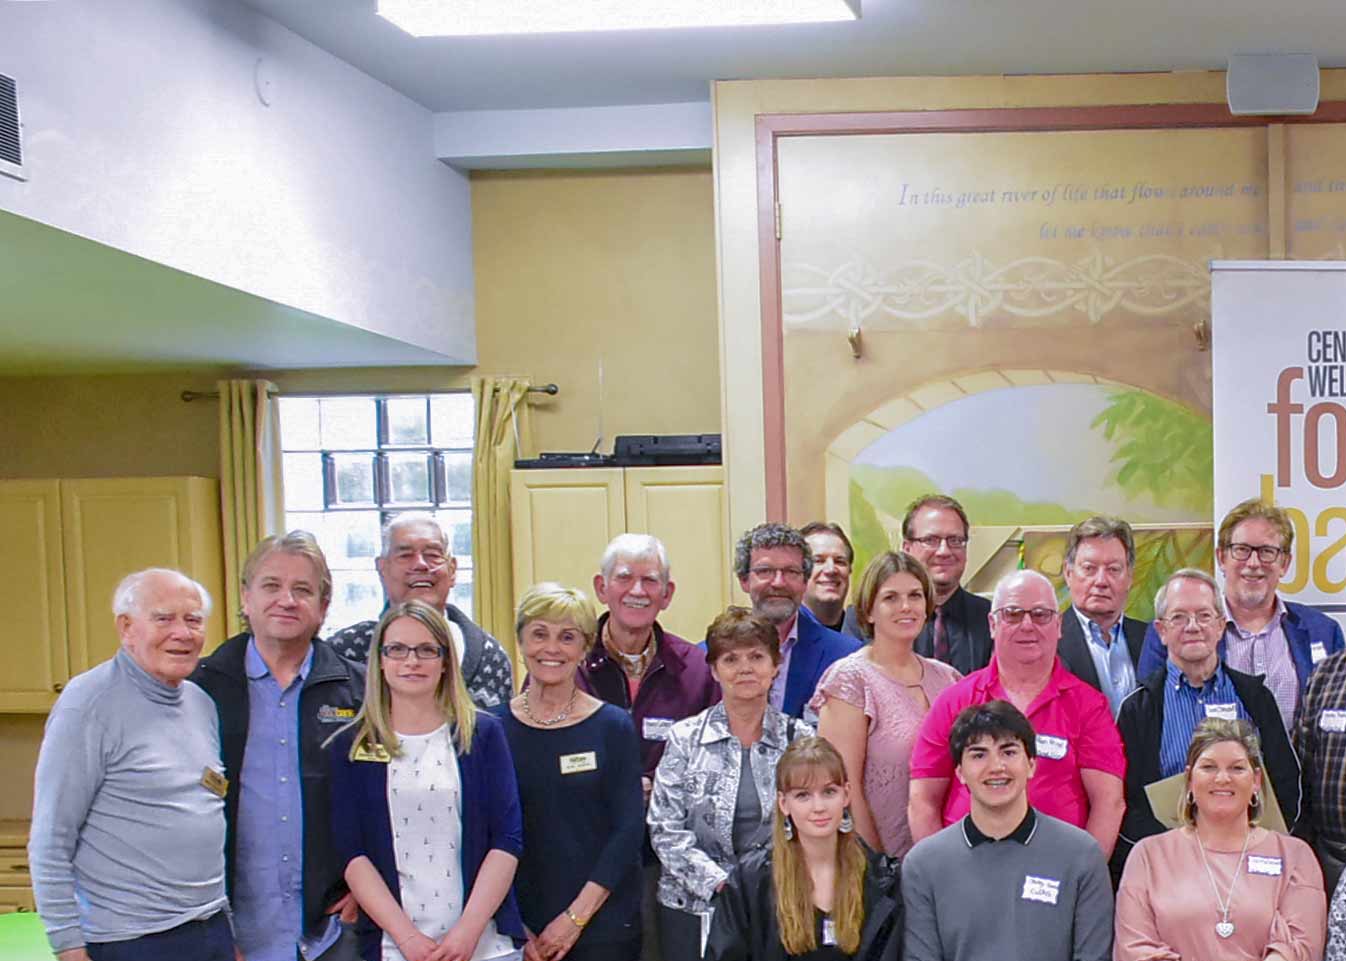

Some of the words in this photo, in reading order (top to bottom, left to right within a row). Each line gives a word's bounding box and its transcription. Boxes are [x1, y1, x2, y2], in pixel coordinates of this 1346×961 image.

[897, 183, 918, 206] In
[923, 187, 953, 205] this
[954, 189, 996, 208] great
[1001, 189, 1038, 204] river
[1041, 184, 1058, 207] of
